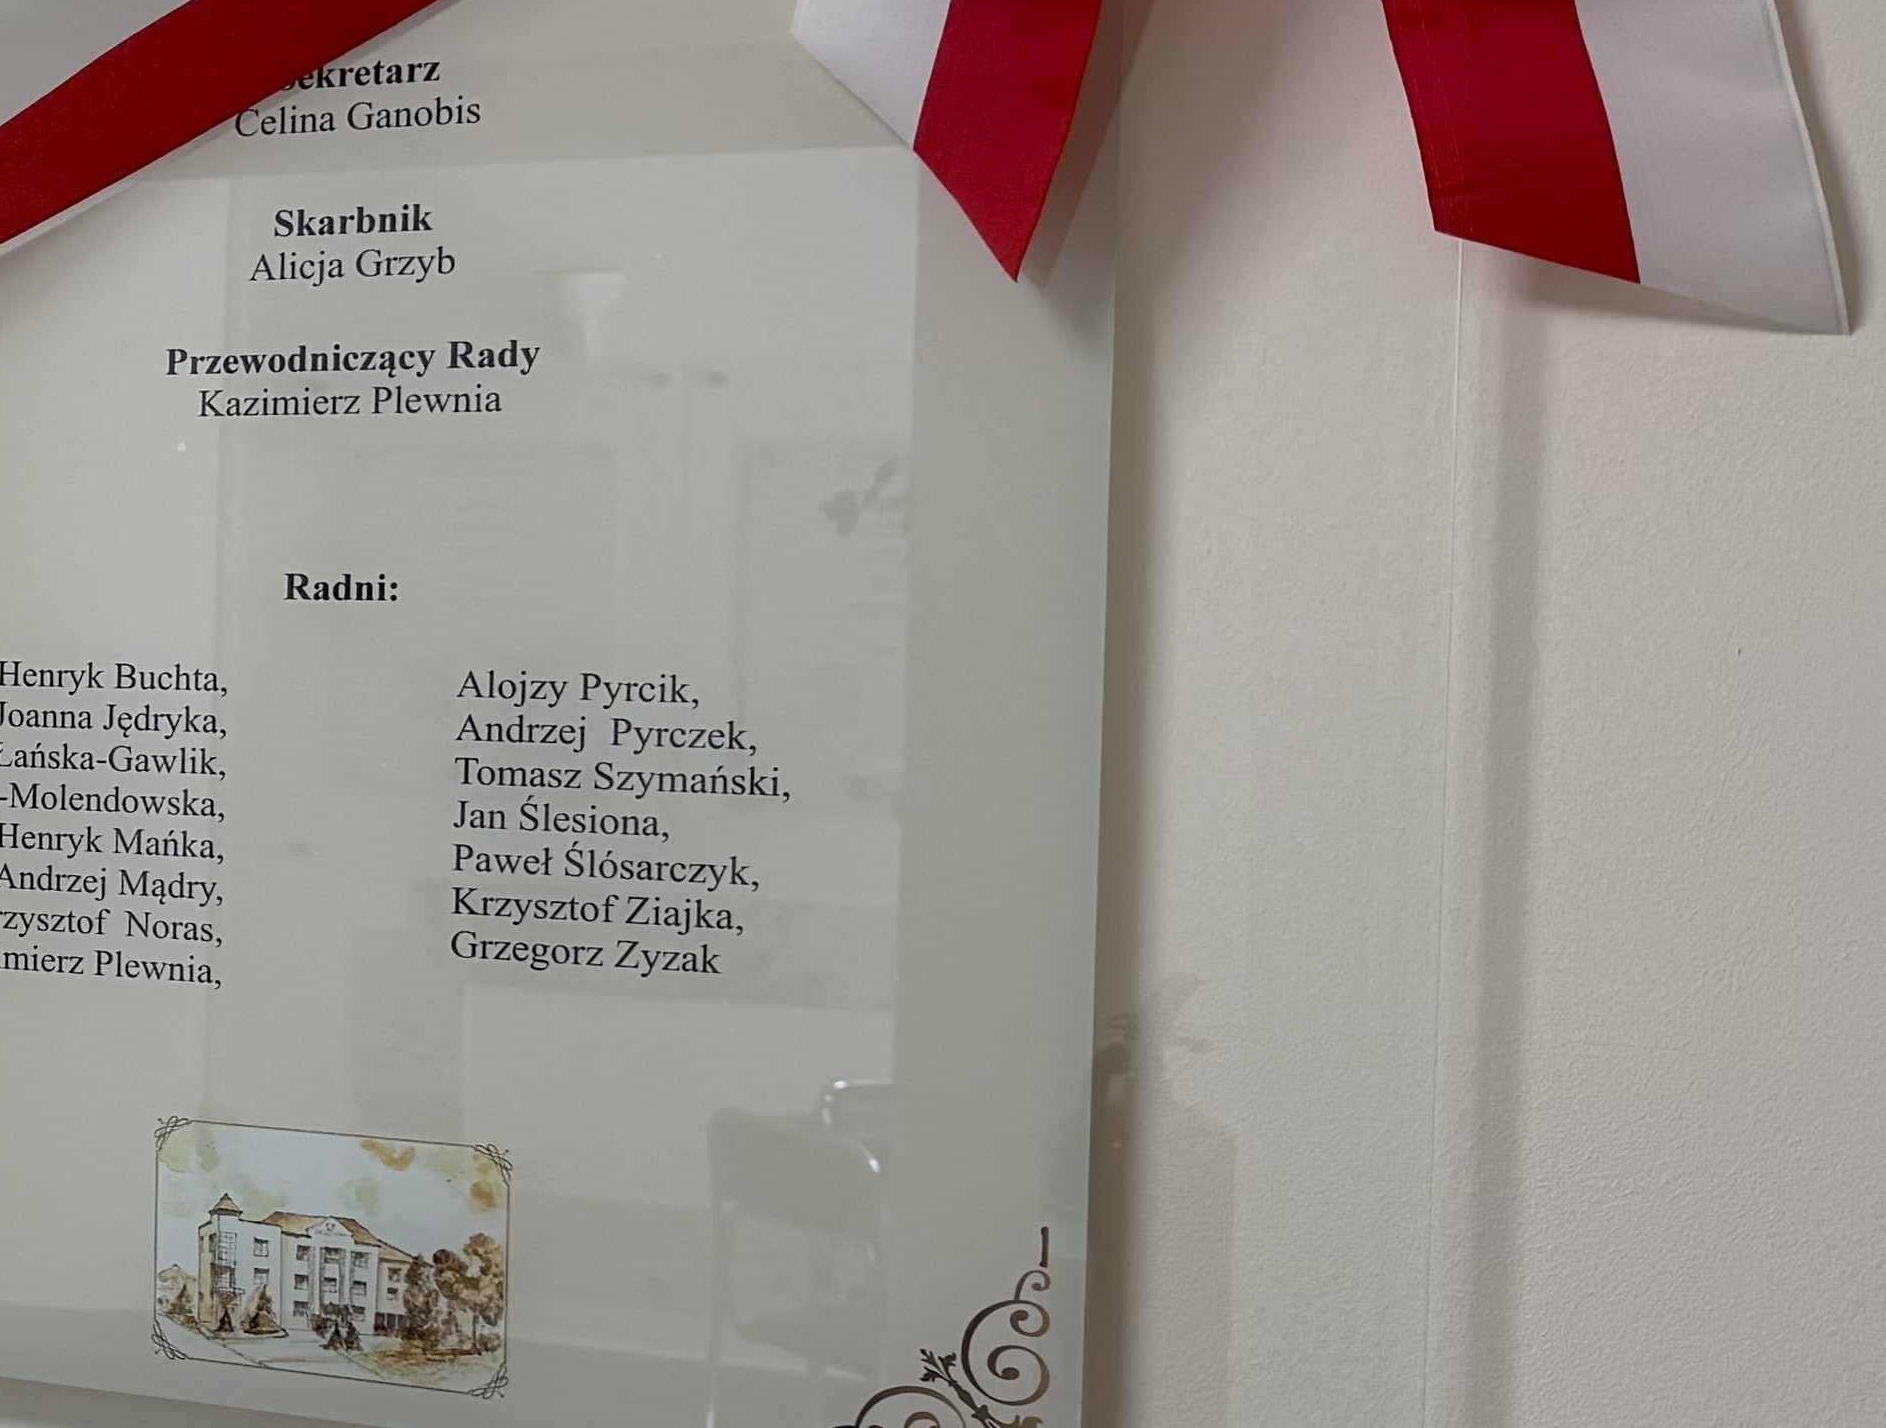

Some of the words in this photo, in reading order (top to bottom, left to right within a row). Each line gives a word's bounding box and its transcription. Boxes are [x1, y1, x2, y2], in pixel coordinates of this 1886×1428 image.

[234, 105, 336, 137] Celina
[347, 96, 481, 130] Ganobis
[274, 203, 433, 237] Skarbnik
[249, 250, 345, 287] Alicja
[356, 246, 455, 283] Grzyb
[166, 344, 436, 378] Przewodniczący
[447, 339, 541, 375] Rady
[199, 387, 360, 417] Kazimierz
[372, 383, 502, 414] Plewnia
[284, 573, 398, 602] Radni:
[114, 663, 227, 697] Buchta,
[456, 670, 568, 708] Alojzy
[580, 673, 699, 710] Pyrcik,
[103, 704, 226, 740] Jędryka,
[455, 714, 585, 753] Andrzej
[610, 718, 756, 757] Pyrczek,
[454, 757, 582, 789] Tomasz
[594, 762, 790, 803] Szymański,
[453, 800, 507, 830] Jan
[519, 803, 669, 843] Ślesiona,
[113, 827, 224, 865] Mańka,
[118, 869, 223, 907] Mądry,
[452, 844, 553, 876] Paweł
[565, 848, 759, 892] Ślósarczyk,
[124, 911, 222, 948] Noras,
[451, 887, 620, 926] Krzysztof
[625, 896, 743, 936] Ziajka,
[94, 950, 221, 990] Plewnia,
[451, 930, 604, 971] Grzegorz
[614, 940, 721, 978] Zyzak
